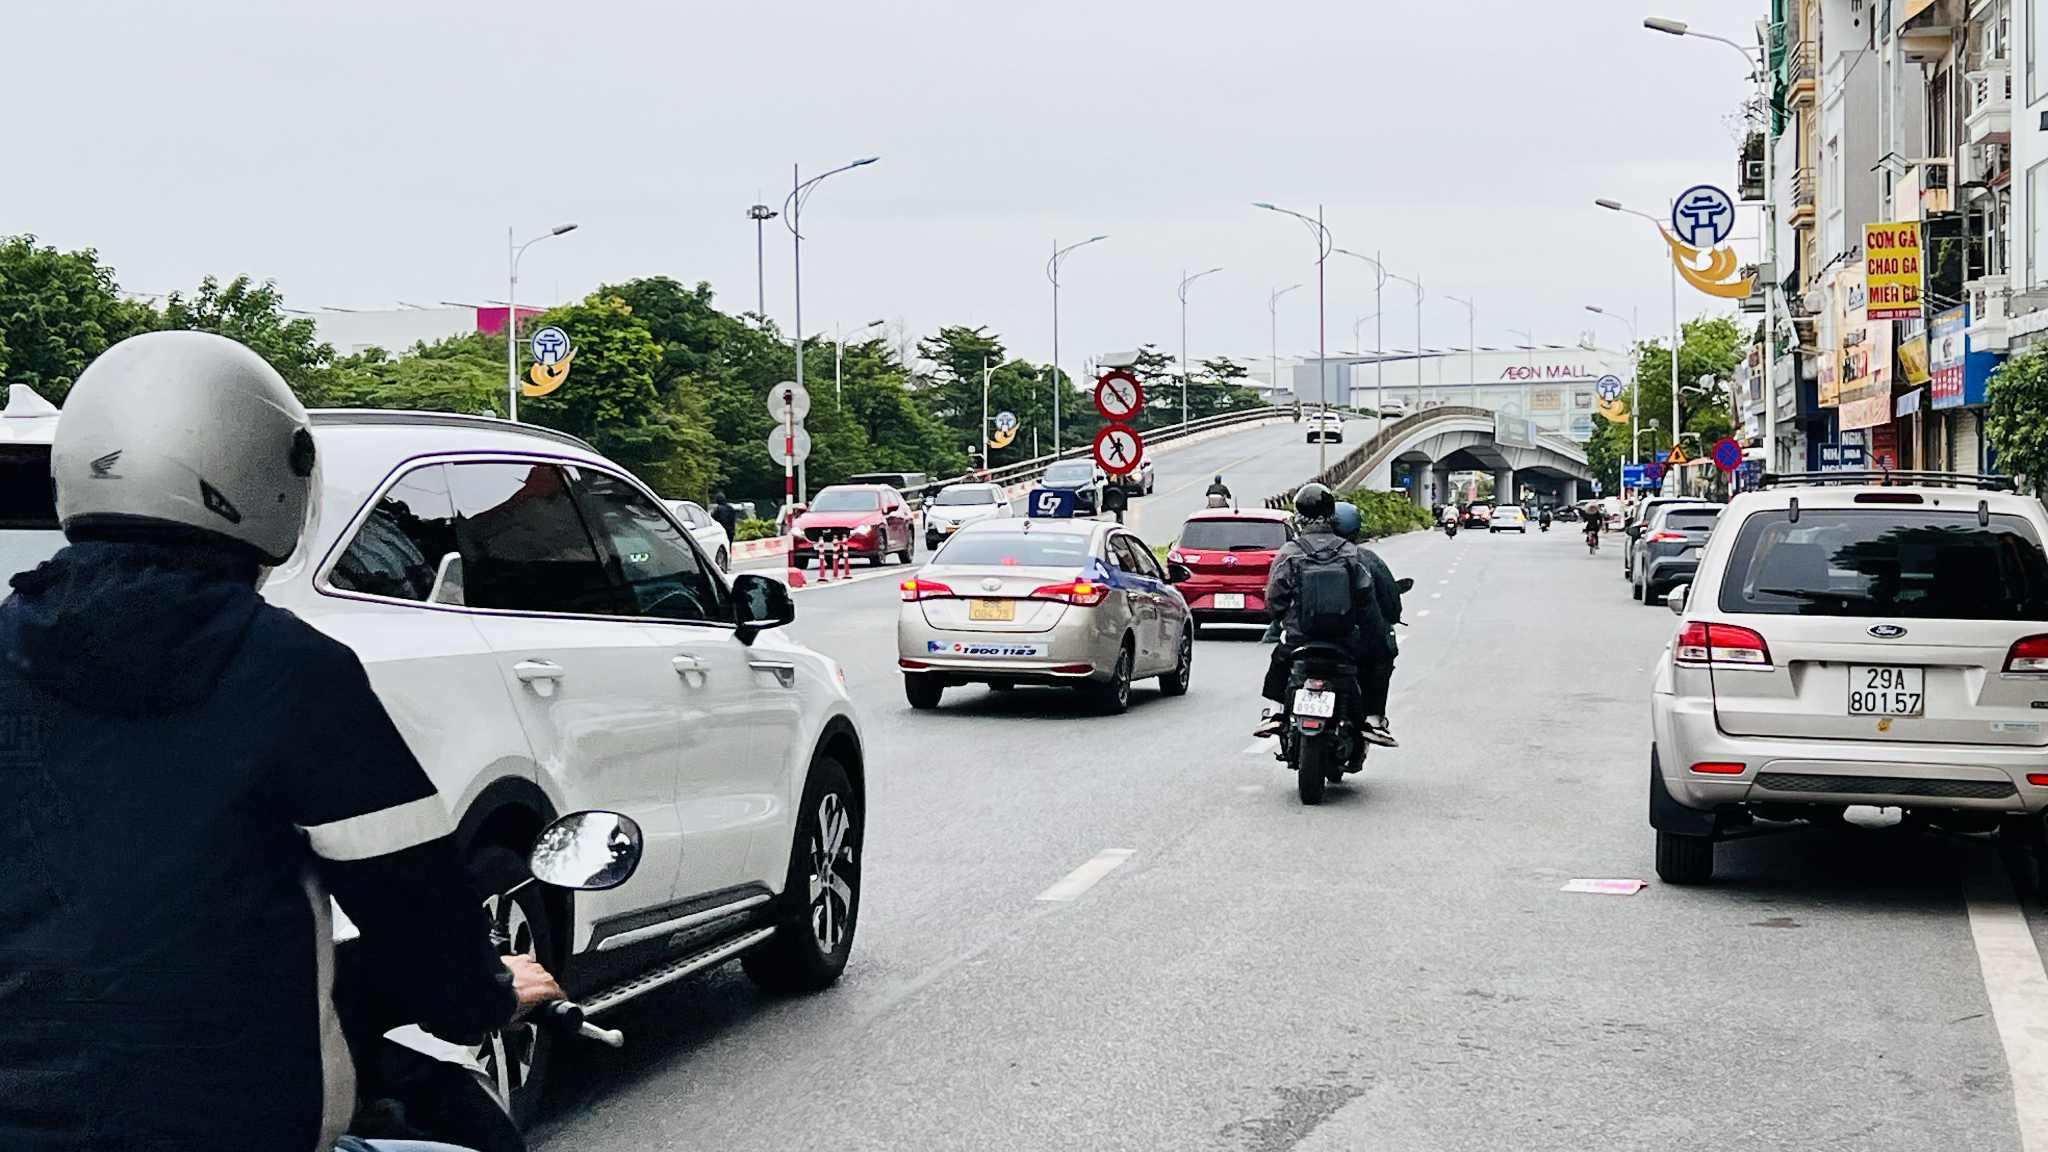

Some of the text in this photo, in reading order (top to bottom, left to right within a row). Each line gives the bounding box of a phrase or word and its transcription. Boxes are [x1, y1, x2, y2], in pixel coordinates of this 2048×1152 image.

[1546, 365, 1587, 378] MALL
[1867, 668, 1905, 690] 29A
[1851, 691, 1921, 713] 801.57
